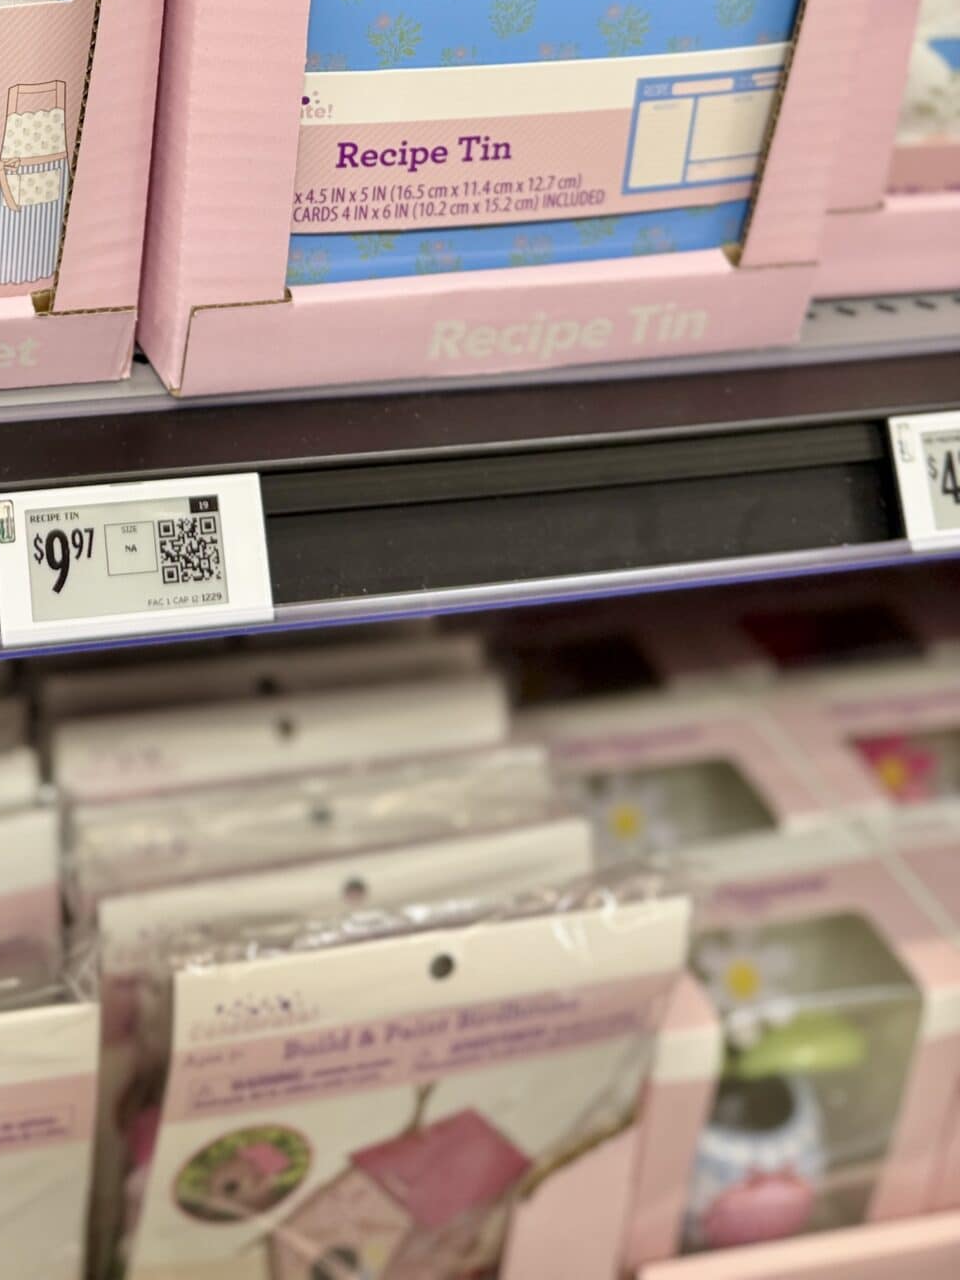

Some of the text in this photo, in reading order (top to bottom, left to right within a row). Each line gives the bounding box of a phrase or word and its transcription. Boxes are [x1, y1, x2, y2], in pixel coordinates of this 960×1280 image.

[335, 135, 513, 172] Recipe Tin
[294, 173, 583, 204] x 4.5 IN x 5 IN (16.5 cm x 11.4 cm x 12.7 cm)
[292, 189, 606, 222] CARDS 4 IN x 6 IN (10.2 cm x 15.2 cm) INCLUDED
[425, 300, 711, 360] Recipe Tin
[29, 511, 80, 523] RECIPE TIN
[124, 544, 138, 553] NA
[201, 592, 222, 602] 1229
